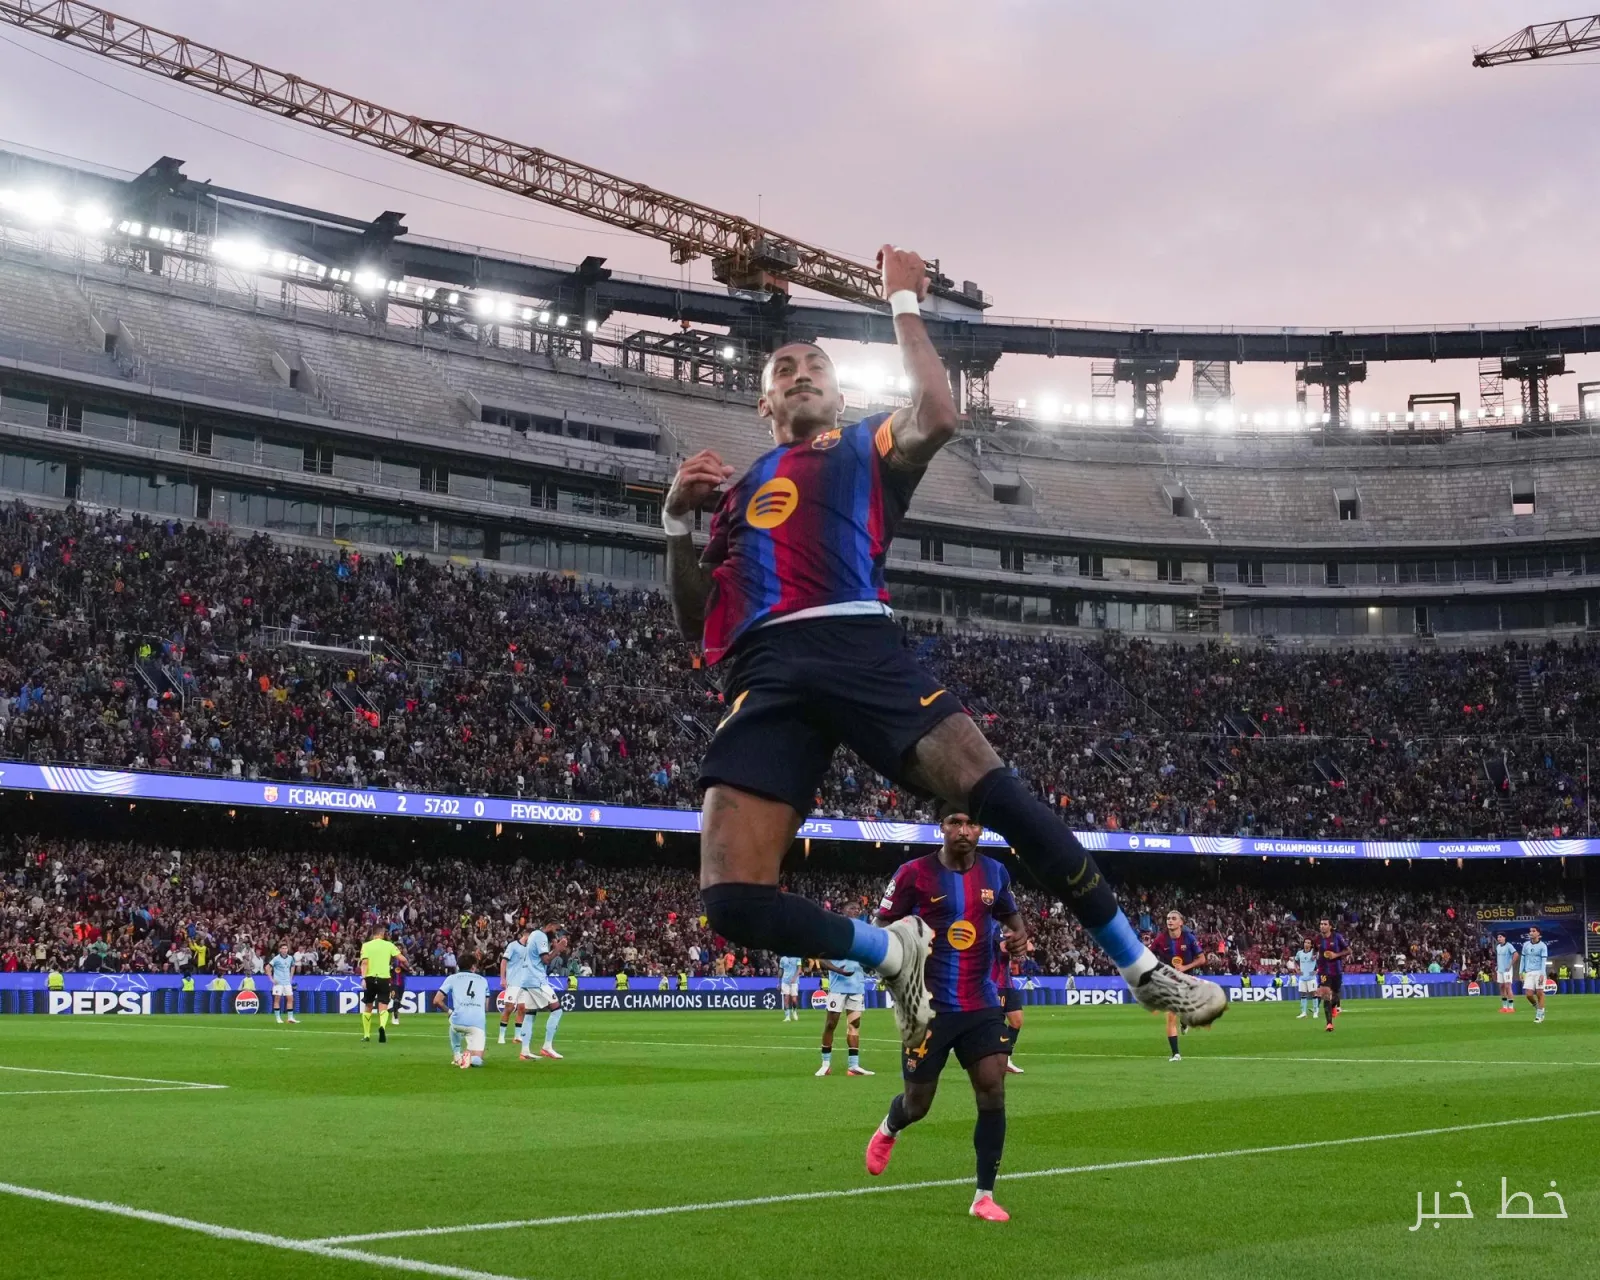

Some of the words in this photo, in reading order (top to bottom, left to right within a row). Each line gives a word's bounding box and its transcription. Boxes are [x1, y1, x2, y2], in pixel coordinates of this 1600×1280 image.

[288, 788, 304, 804] FC
[304, 790, 376, 809] BARCELONA
[397, 795, 407, 812] 2
[424, 798, 460, 815] 57:02
[474, 800, 485, 817] 0
[511, 803, 582, 822] FEYENOORD
[1144, 837, 1171, 849] PEPSI
[1254, 842, 1274, 852] UEFA
[1275, 843, 1322, 853] CHAMPIONS
[1323, 844, 1356, 854] LEAGUE
[1438, 844, 1466, 854] QATAR
[1466, 844, 1501, 853] AIRWAYS
[466, 980, 476, 999] 4
[1229, 987, 1282, 1003] PEPSI
[1381, 984, 1429, 999] PEPSI
[49, 991, 151, 1014] PEPSI
[236, 1000, 258, 1008] PEPSI
[340, 991, 425, 1014] PSI
[583, 995, 620, 1009] UEFA
[623, 995, 702, 1009] CHAMPIONS
[707, 995, 756, 1008] LEAGUE
[1066, 989, 1123, 1006] PEPSI
